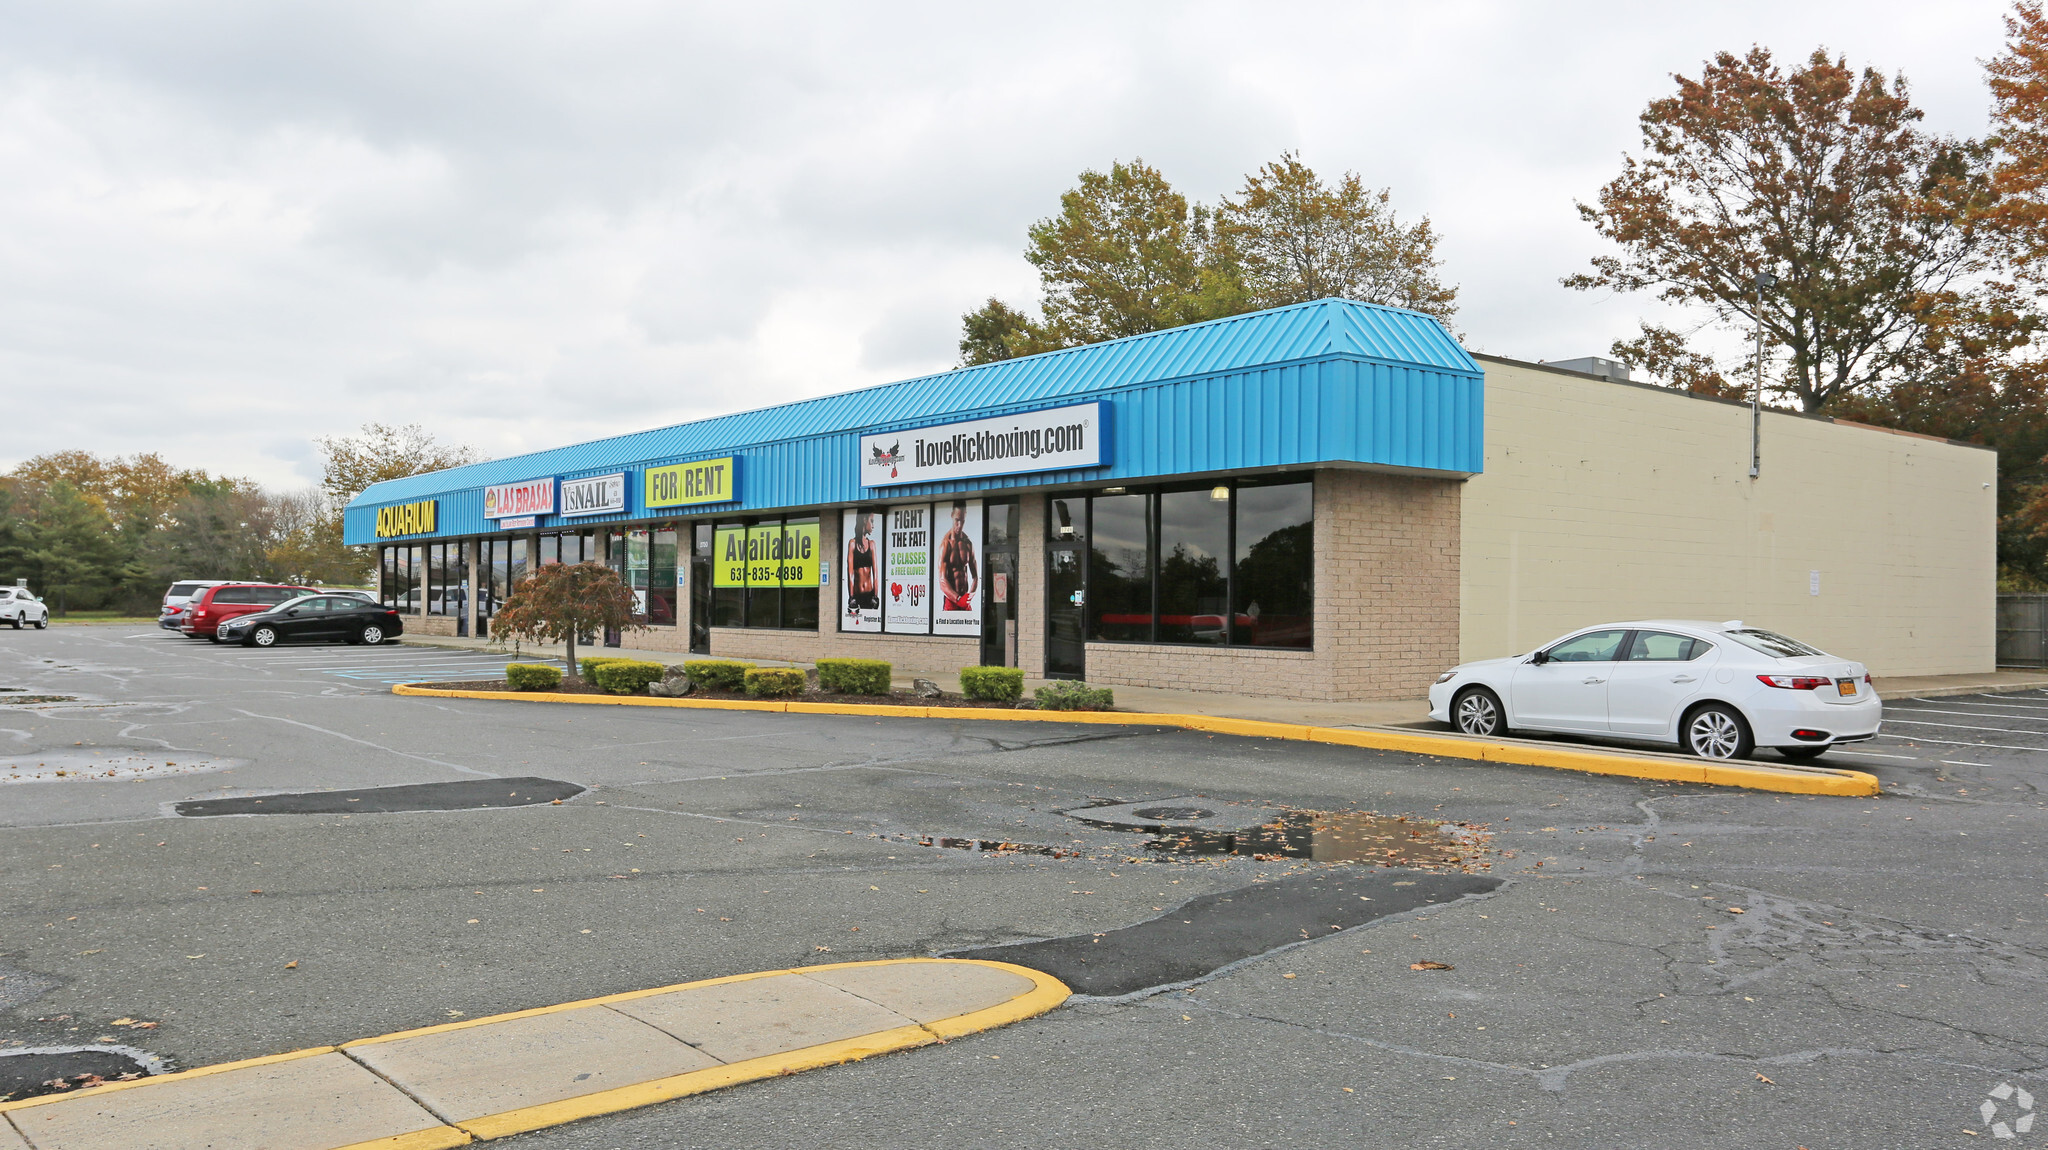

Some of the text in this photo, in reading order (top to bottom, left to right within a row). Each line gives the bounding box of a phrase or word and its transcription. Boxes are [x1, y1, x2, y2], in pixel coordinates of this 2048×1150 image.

[915, 423, 1083, 467] iLoveKickboxing.com
[653, 465, 724, 501] FOR RENT
[497, 482, 552, 514] LAS BRASAS
[375, 500, 435, 538] AQUARIUM
[894, 509, 924, 529] FIGHT
[725, 529, 811, 561] Available
[891, 530, 926, 547] THE FAT!
[891, 551, 927, 565] 3 CLASSES
[891, 568, 895, 576] &
[895, 566, 906, 576] FREE
[730, 565, 803, 581] 631-835-4898
